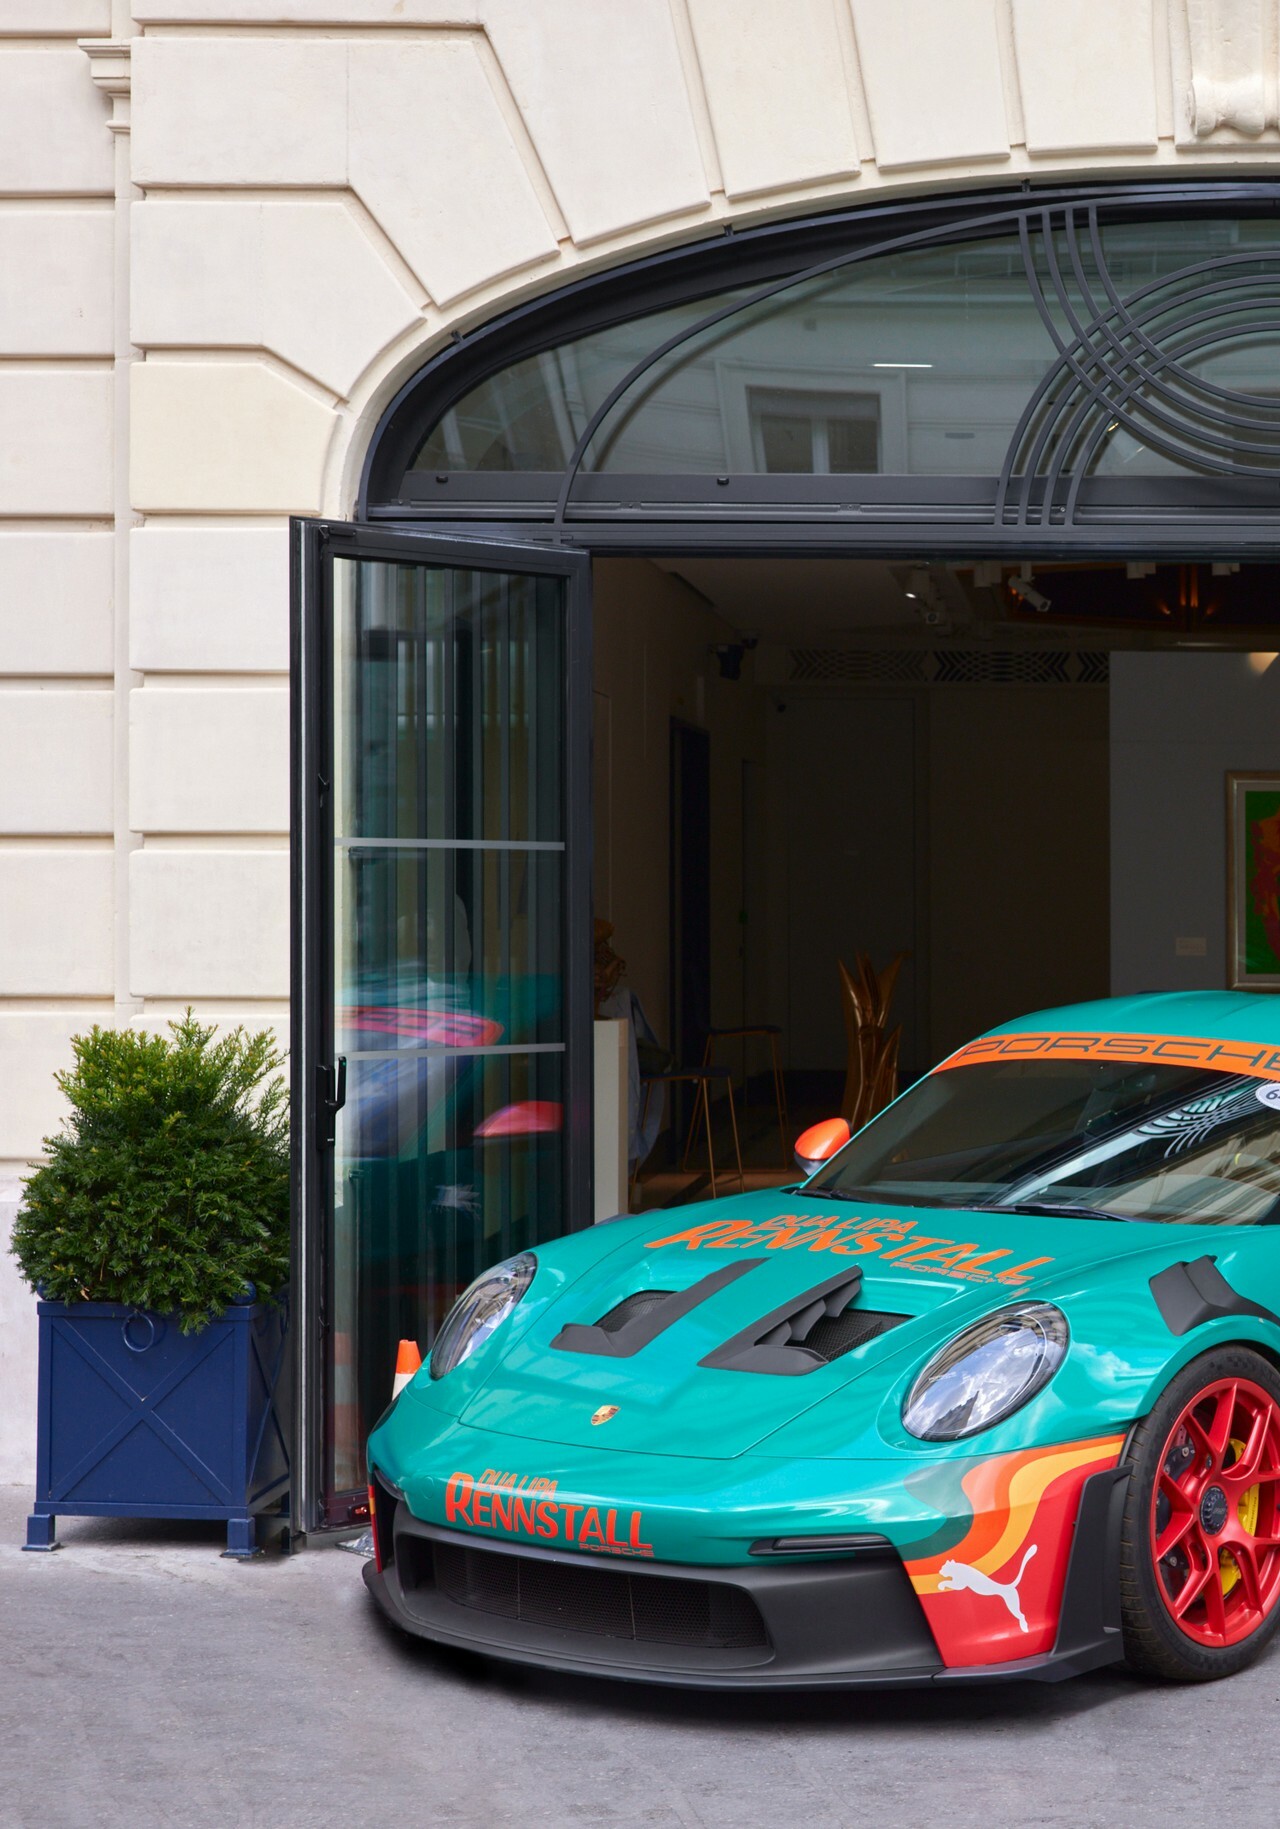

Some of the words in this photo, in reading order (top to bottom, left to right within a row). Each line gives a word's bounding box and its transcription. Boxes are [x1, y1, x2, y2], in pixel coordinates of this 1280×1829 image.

[763, 1215, 840, 1230] DUA
[838, 1216, 919, 1234] LIPA
[644, 1220, 1056, 1282] RENNSTALL
[889, 1261, 1030, 1286] PORSCHE
[477, 1468, 518, 1493] DUA
[517, 1475, 558, 1500] LIPA
[445, 1471, 652, 1549] RENNSTALL
[579, 1542, 654, 1557] PORSCHE
